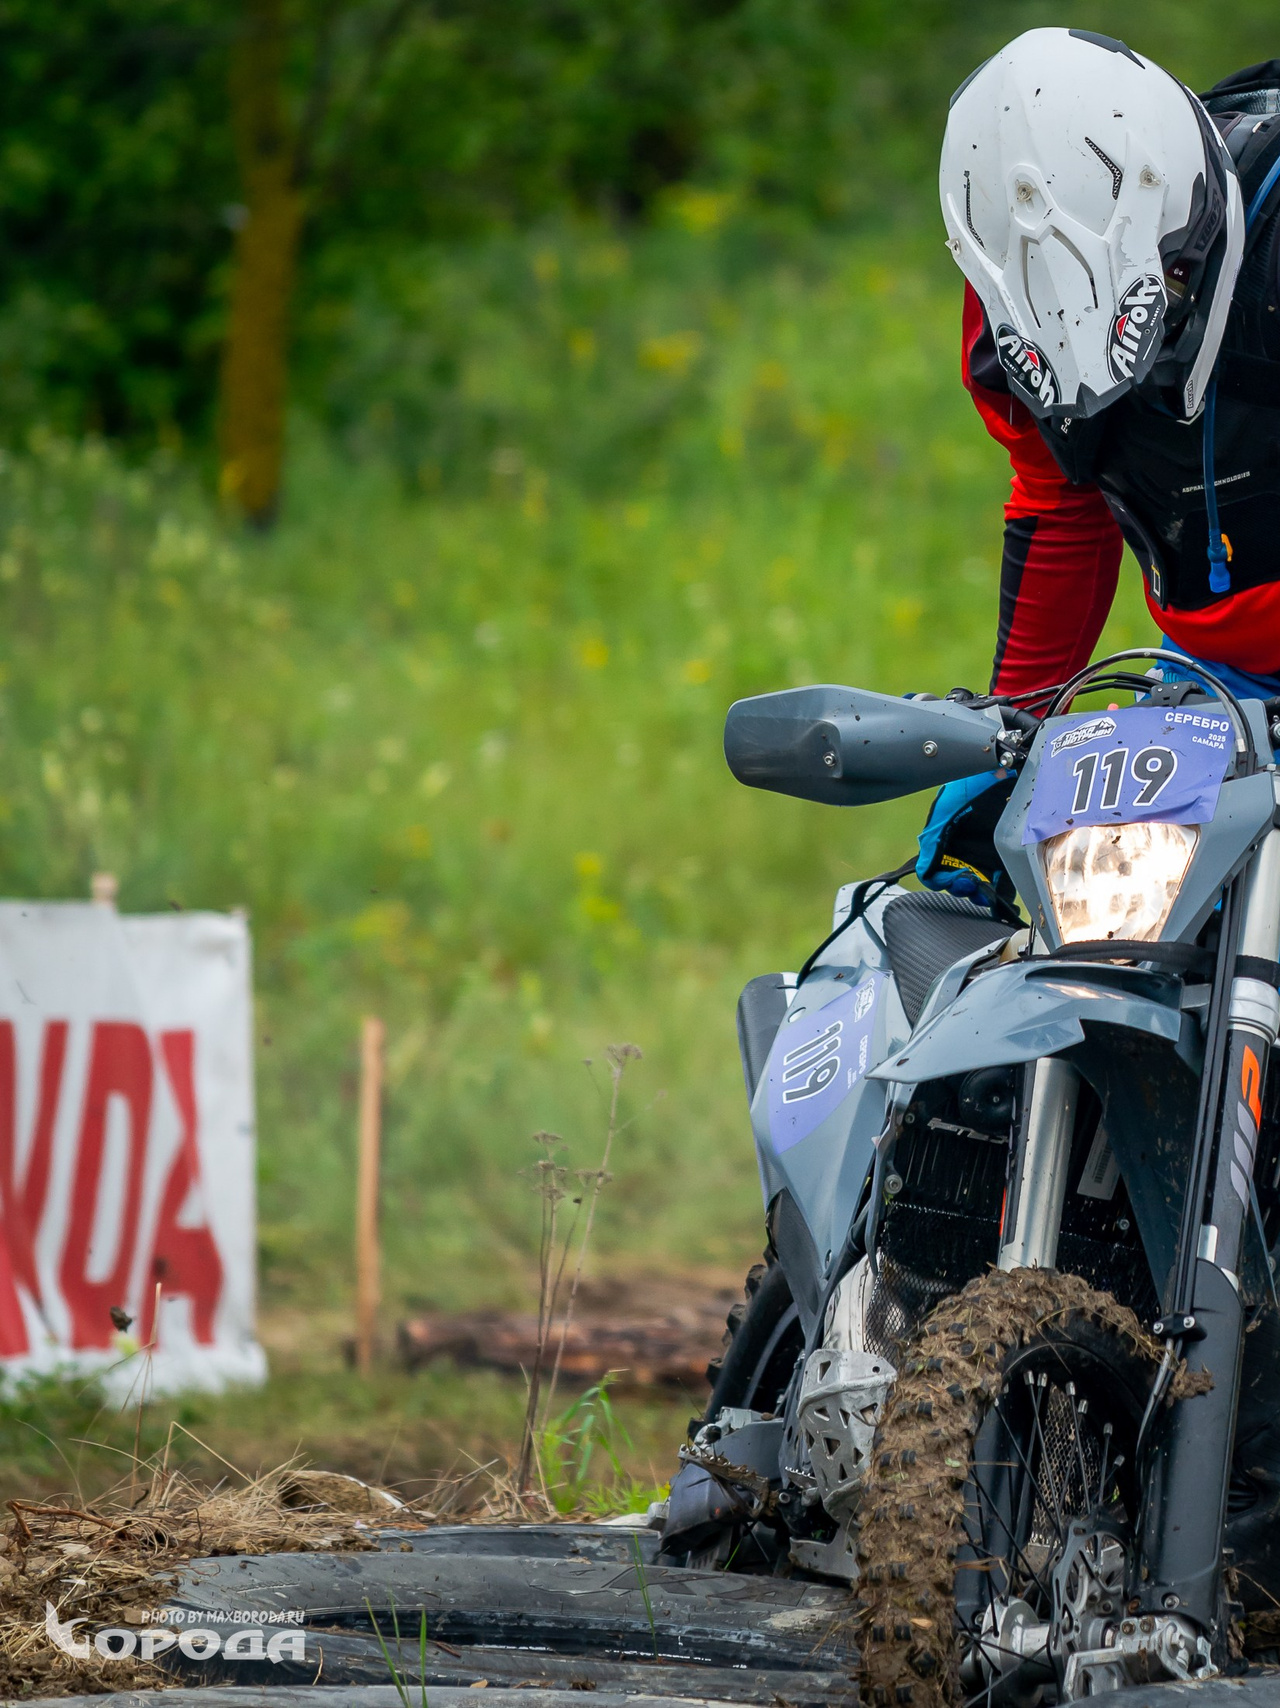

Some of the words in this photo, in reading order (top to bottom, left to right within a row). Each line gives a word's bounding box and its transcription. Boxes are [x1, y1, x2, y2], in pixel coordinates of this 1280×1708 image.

[1111, 283, 1161, 378] Airoh
[998, 334, 1055, 408] Airoh
[1165, 712, 1230, 732] СЕРЕБРО
[1191, 735, 1225, 750] САМАРА
[1208, 733, 1227, 743] 2025
[1071, 746, 1178, 815] 119
[782, 1020, 844, 1104] 119
